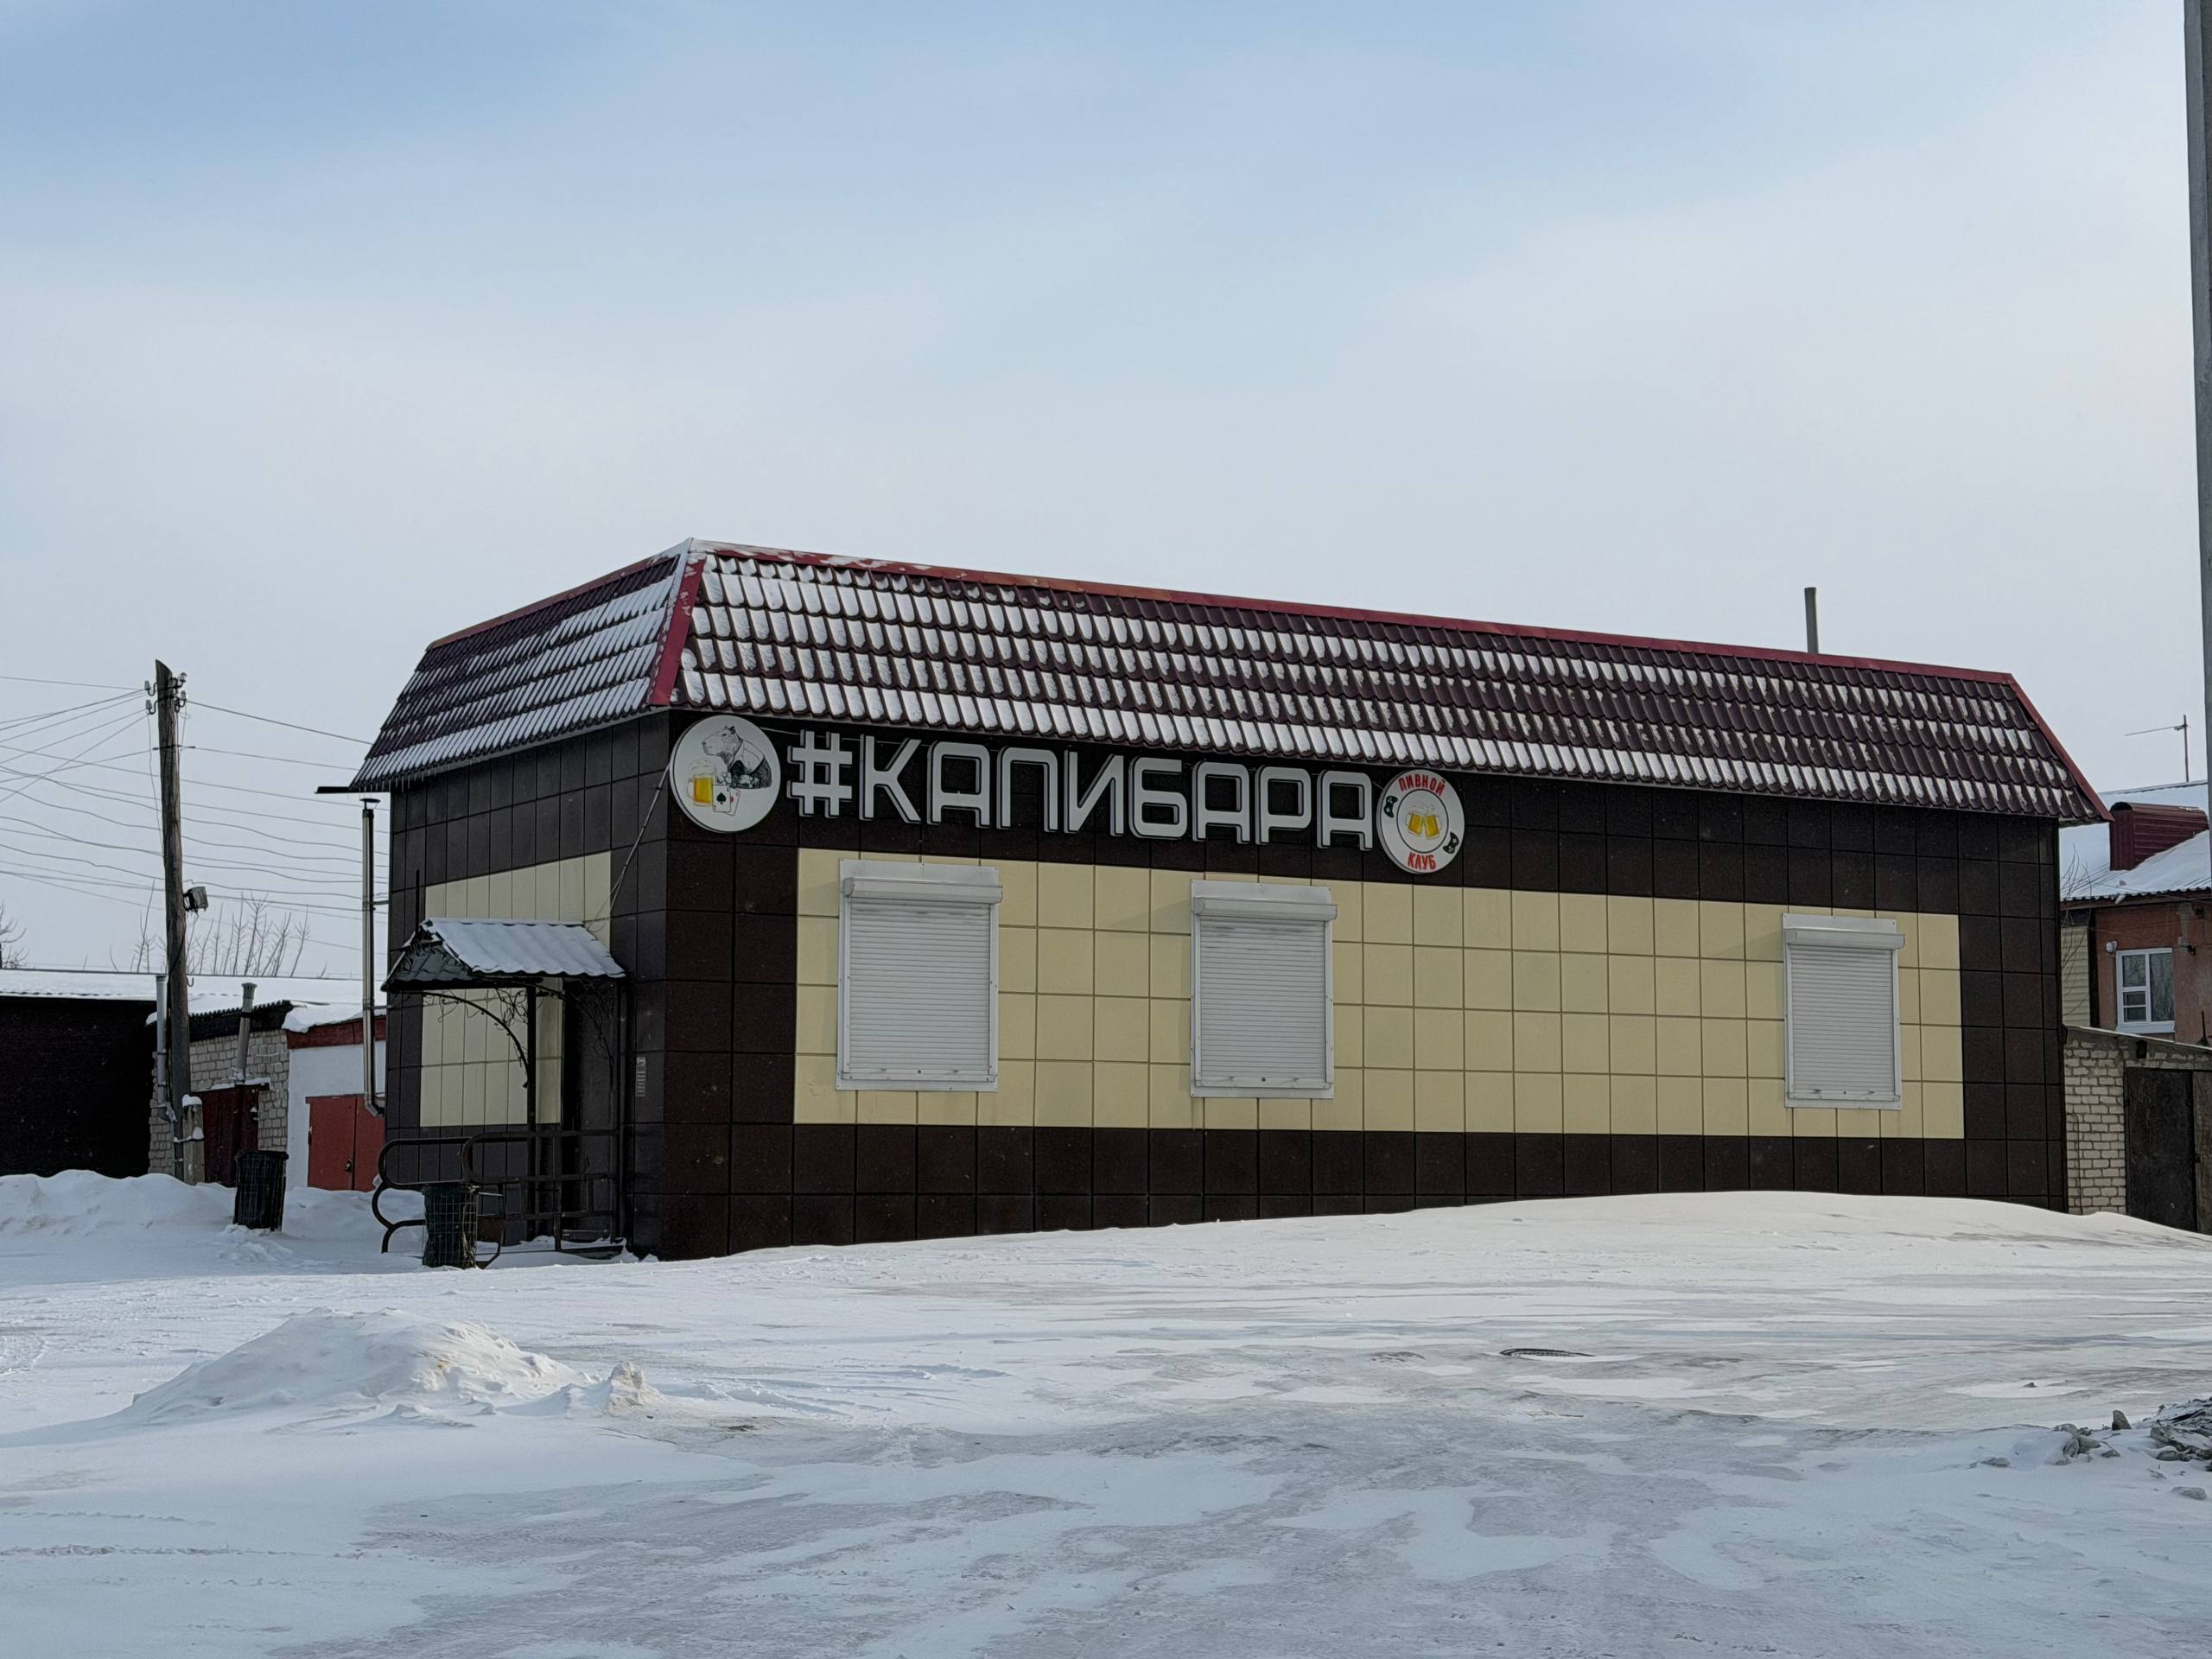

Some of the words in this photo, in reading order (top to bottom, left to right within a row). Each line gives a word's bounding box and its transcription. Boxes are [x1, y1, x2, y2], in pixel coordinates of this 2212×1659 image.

[787, 729, 1373, 851] #КАПИБАРА
[1398, 774, 1446, 797] ПИВНОЙ
[1407, 852, 1436, 871] КЛУБ
